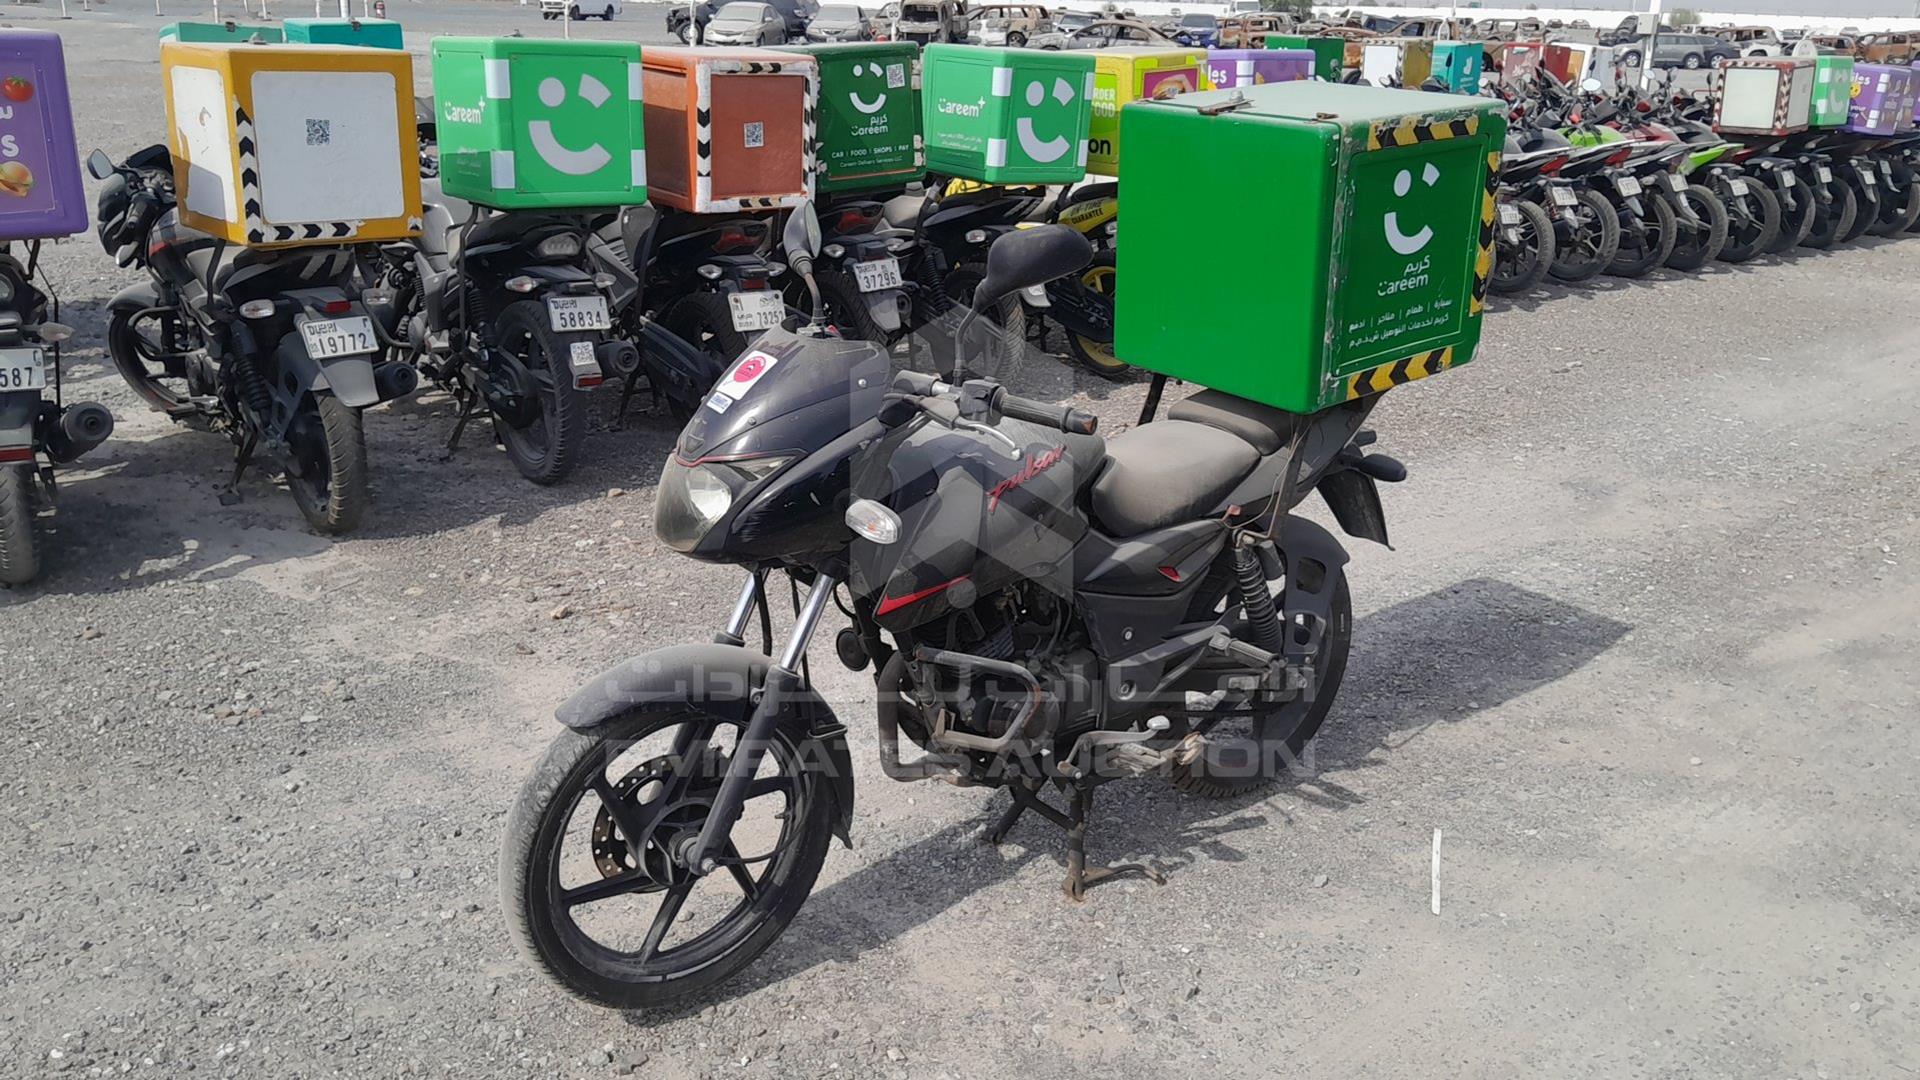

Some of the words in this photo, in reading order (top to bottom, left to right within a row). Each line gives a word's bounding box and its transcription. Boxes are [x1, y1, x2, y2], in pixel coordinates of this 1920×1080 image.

[870, 113, 888, 126] كريم
[851, 125, 889, 136] Careem
[850, 149, 867, 157] FOOD
[873, 146, 893, 154] SHOPS
[1404, 254, 1430, 277] كريم
[863, 271, 896, 289] 37296
[1377, 274, 1428, 296] Careem
[559, 310, 603, 328] 58834
[1405, 304, 1424, 318] طعام
[1434, 312, 1449, 326] كريم
[318, 332, 369, 355] 19772
